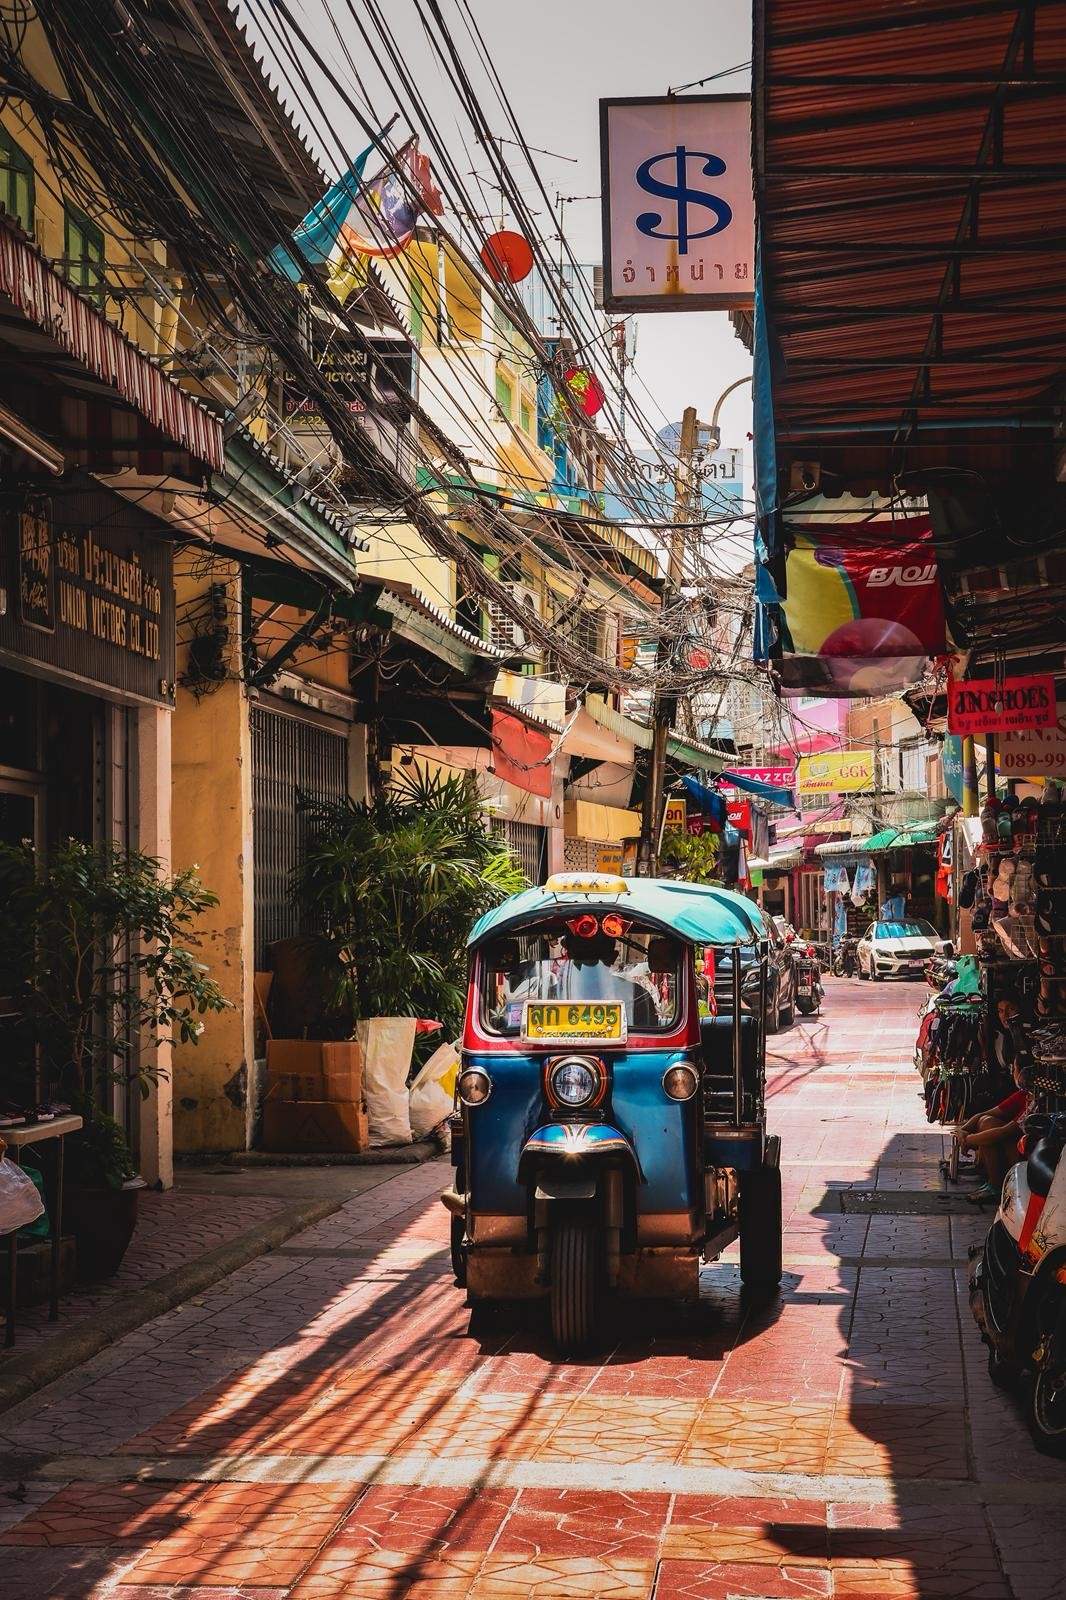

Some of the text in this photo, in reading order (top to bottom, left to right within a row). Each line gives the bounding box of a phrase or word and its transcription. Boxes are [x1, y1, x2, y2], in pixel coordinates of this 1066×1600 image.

[622, 260, 748, 283] จำหน่าย
[866, 564, 938, 588] BAOJI
[60, 580, 88, 632] UNION
[91, 594, 127, 647] VICTORS
[840, 765, 869, 778] GGK
[567, 1004, 618, 1026] 6495
